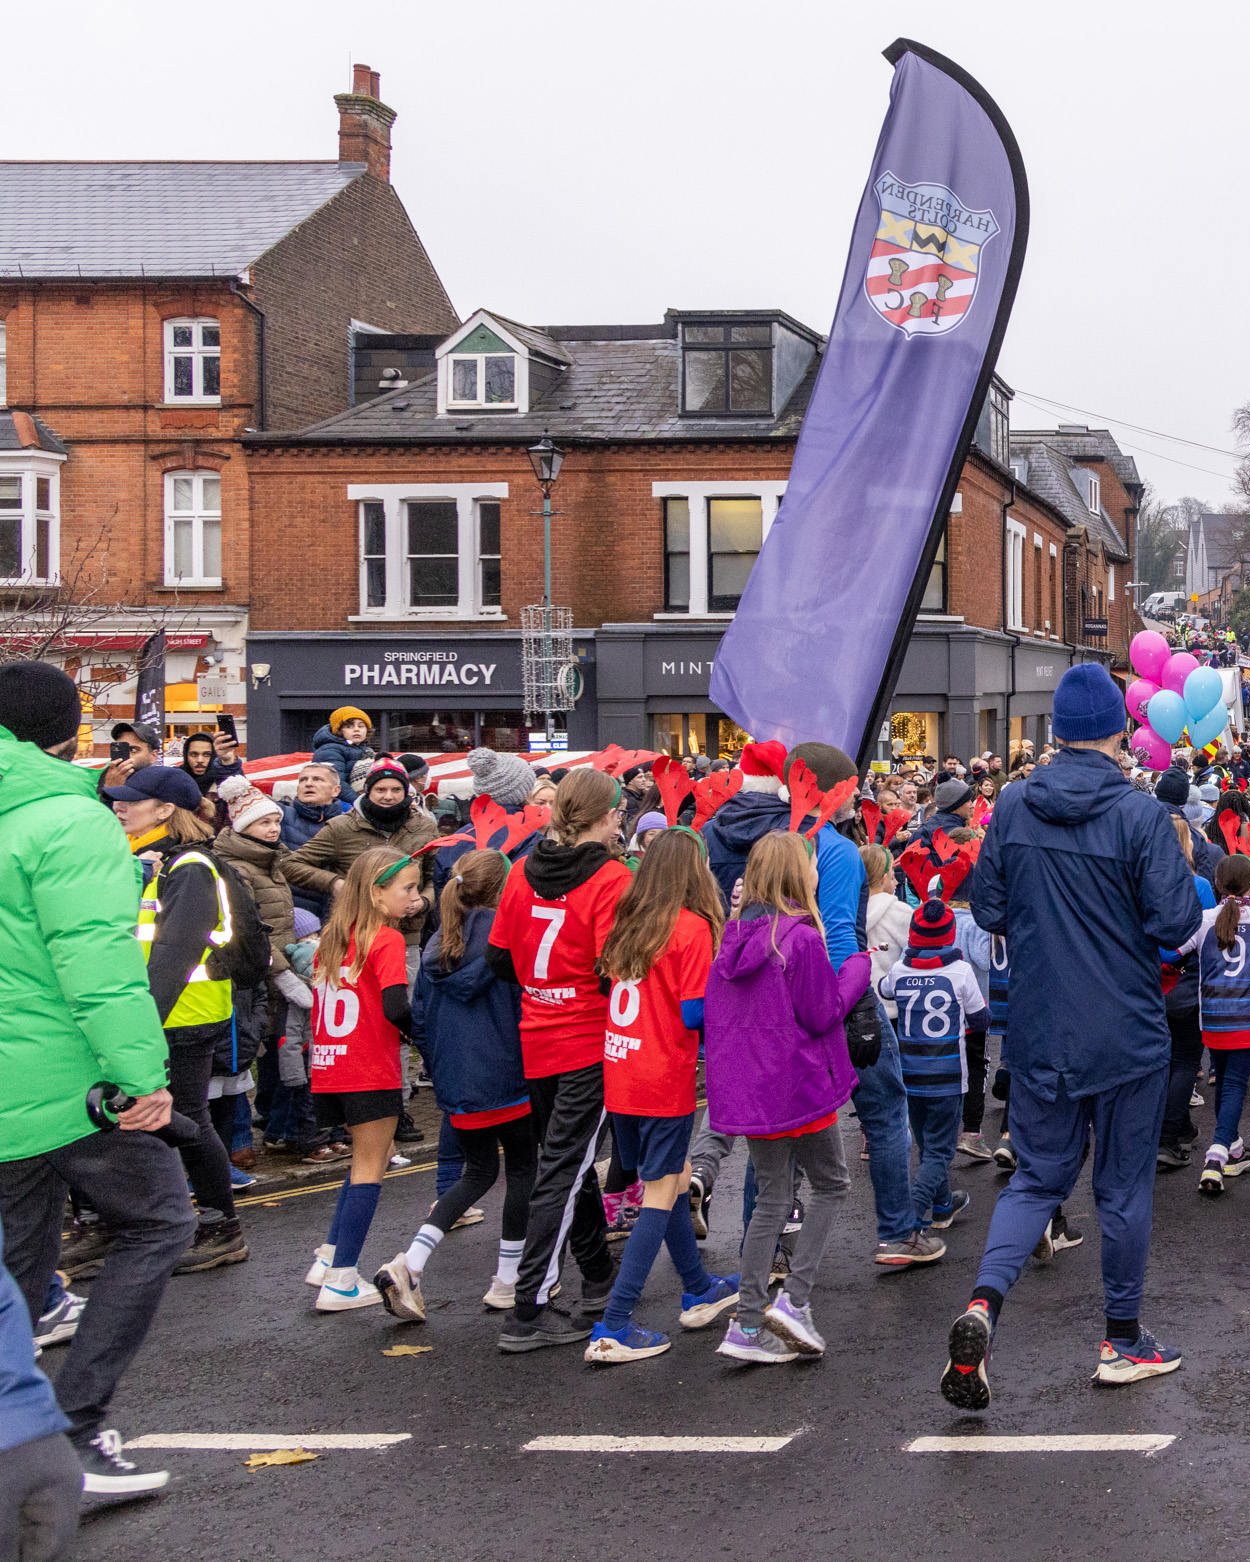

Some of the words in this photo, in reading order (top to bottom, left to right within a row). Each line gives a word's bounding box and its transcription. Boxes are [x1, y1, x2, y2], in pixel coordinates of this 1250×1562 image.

[384, 652, 458, 662] SPRINGFIELD
[344, 664, 497, 686] PHARMACY
[662, 661, 714, 675] MINT
[201, 686, 226, 697] GAIL's
[531, 905, 566, 979] 7
[1222, 934, 1246, 977] 9
[906, 977, 936, 986] COLTS
[896, 989, 953, 1038] 78
[313, 1044, 348, 1055] OUTH
[604, 1041, 628, 1060] ALK
[311, 1055, 335, 1066] ALK
